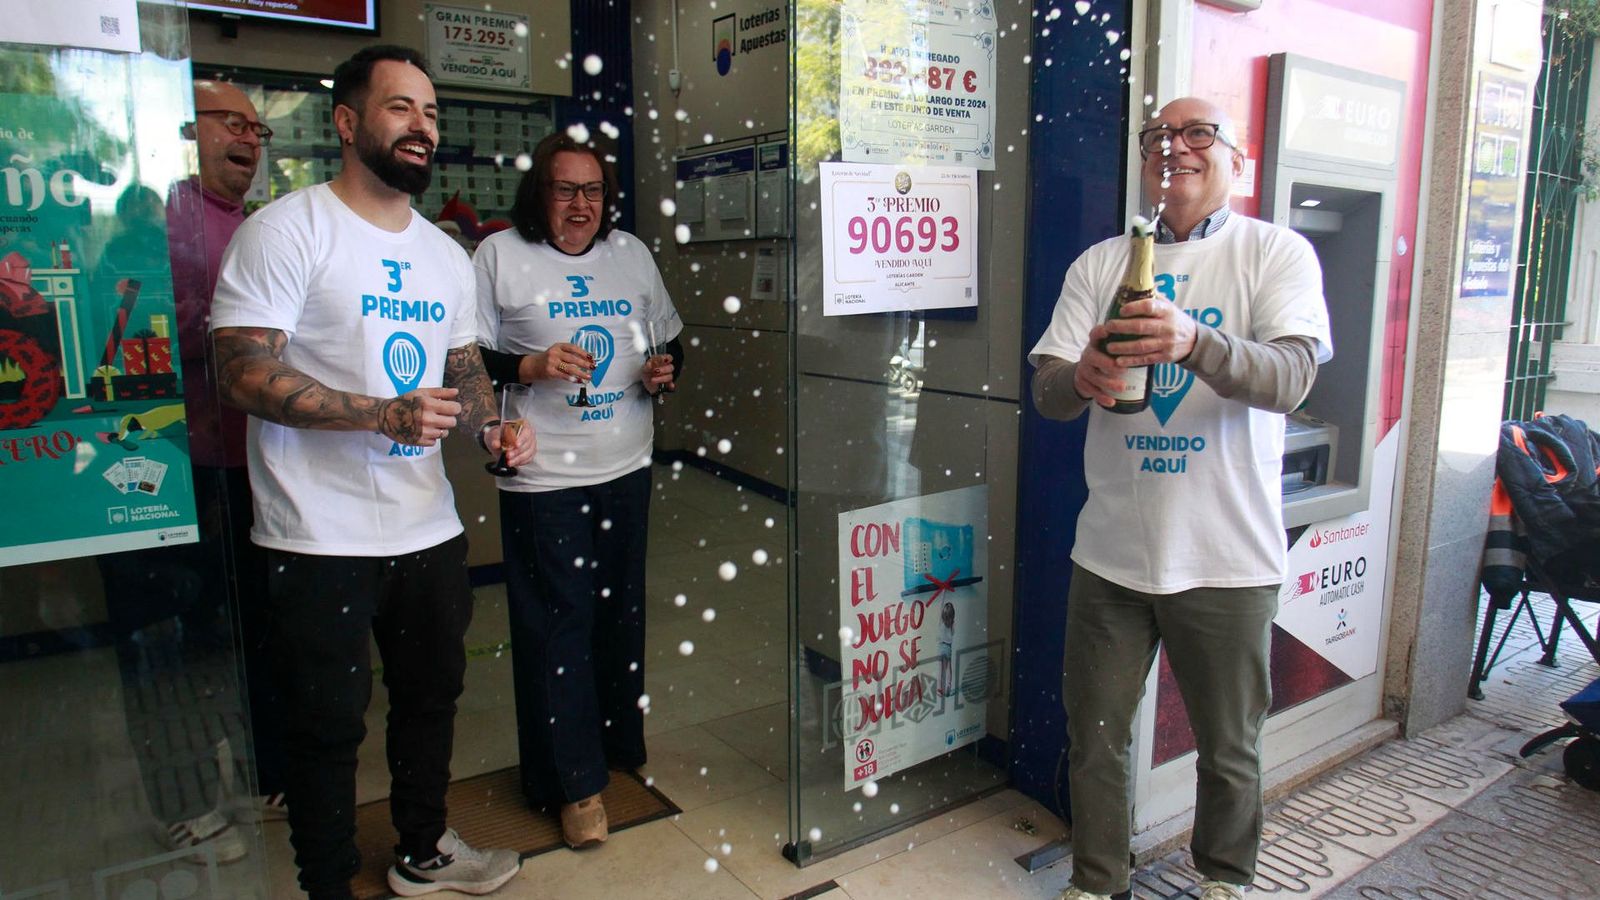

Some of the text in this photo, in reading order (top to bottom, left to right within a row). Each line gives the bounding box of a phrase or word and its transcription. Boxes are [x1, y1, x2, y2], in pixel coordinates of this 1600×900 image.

[436, 11, 471, 24] GRAN
[444, 26, 506, 45] 175.295
[740, 29, 786, 54] Apuestas
[441, 63, 488, 75] VENDIDO
[962, 70, 977, 93] €
[884, 102, 904, 111] ESTE
[906, 104, 931, 115] PUNTO
[933, 107, 944, 116] DE
[945, 109, 971, 118] VENTA
[926, 95, 953, 106] LARGO
[955, 98, 966, 107] DE
[967, 99, 987, 109] 2024
[18, 128, 34, 140] de
[924, 124, 955, 134] GARDEN
[883, 197, 940, 213] PREMIO
[847, 216, 960, 255] 90693
[874, 259, 910, 269] VENDIDO
[361, 294, 446, 323] PREMIO
[548, 299, 632, 319] PREMIO
[566, 391, 625, 406] VNDIDO
[581, 404, 614, 421] AQUÍ
[1125, 434, 1205, 452] VENDIDO
[1140, 454, 1188, 473] AQUÍ
[131, 510, 180, 521] NACIONAL
[851, 521, 900, 558] CON
[1323, 523, 1370, 545] Santander
[1321, 556, 1367, 589] EURO
[851, 566, 878, 607] EL
[1319, 581, 1365, 607] AUTOMATIC CASH
[852, 600, 925, 649] JUEGO
[1325, 627, 1356, 645] TARGOBANK
[852, 636, 923, 691] NO SE
[853, 675, 924, 731] JUEGA
[857, 764, 874, 778] +18
